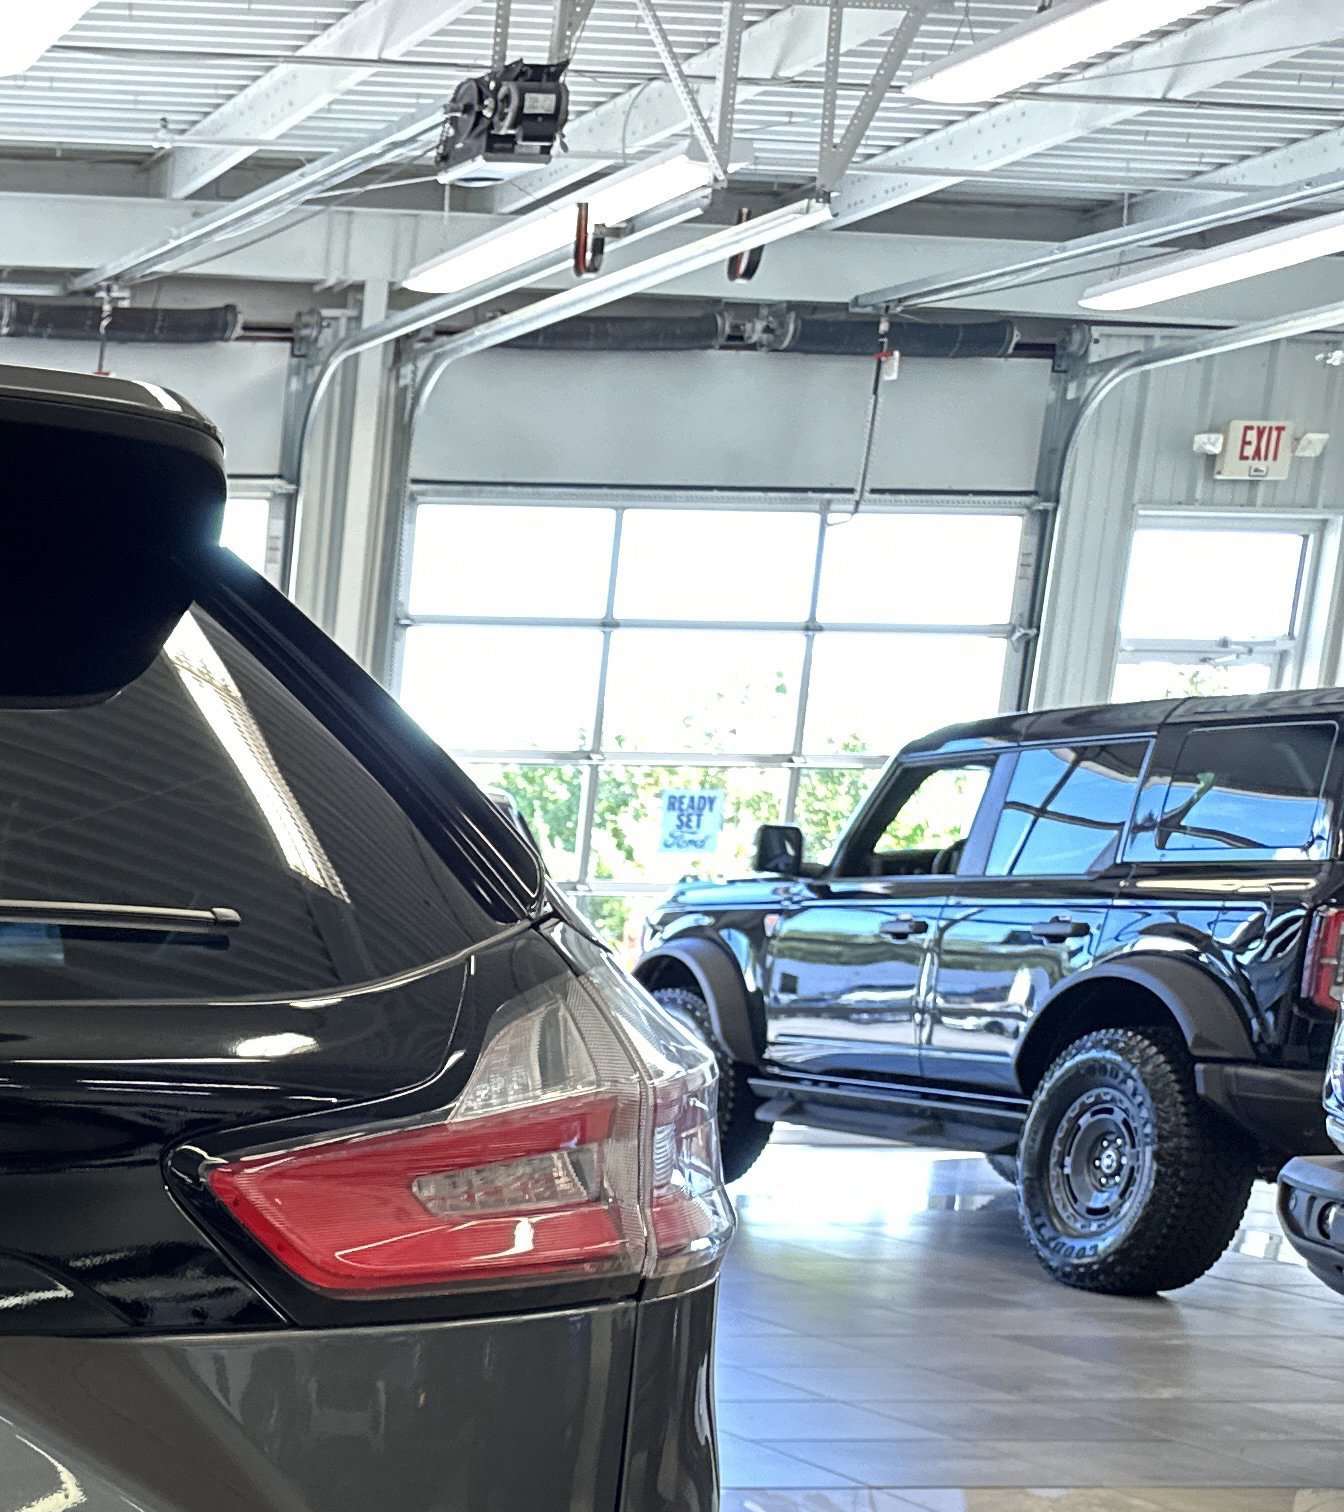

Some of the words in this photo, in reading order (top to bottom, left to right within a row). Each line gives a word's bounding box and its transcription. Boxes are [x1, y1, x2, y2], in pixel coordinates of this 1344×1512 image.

[1238, 425, 1286, 462] EXIT
[667, 794, 717, 813] READY
[675, 813, 704, 830] SET
